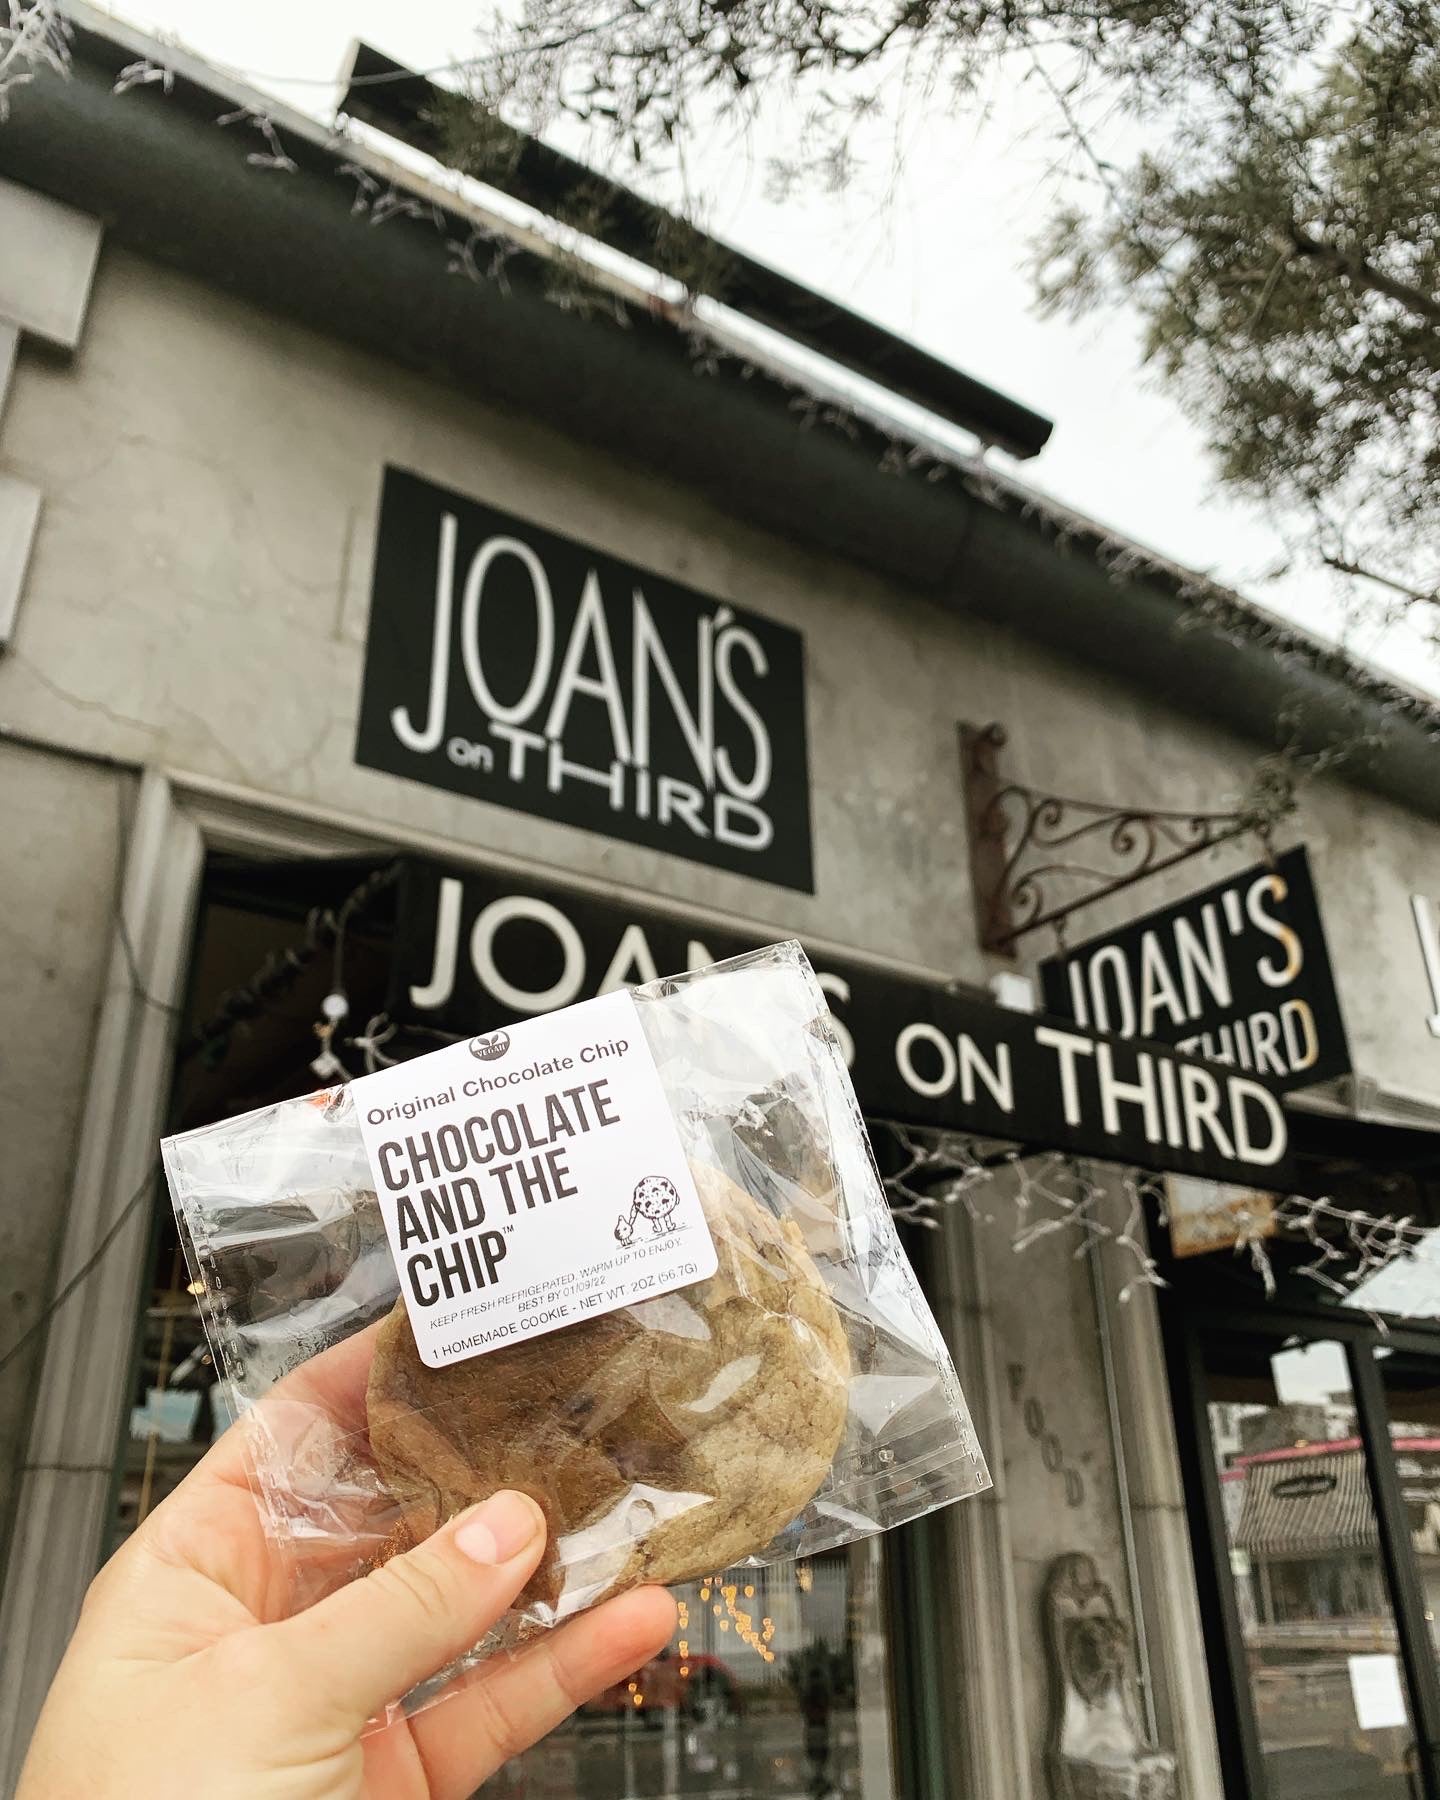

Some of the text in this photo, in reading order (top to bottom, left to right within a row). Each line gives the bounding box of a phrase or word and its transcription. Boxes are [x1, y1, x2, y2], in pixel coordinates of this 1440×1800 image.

[391, 512, 772, 802] JOAN'S
[446, 720, 774, 851] on THIRD
[367, 1039, 629, 1125] Original Chocolate Chip
[895, 1022, 1014, 1113] ON
[1034, 1025, 1288, 1166] THIRD
[378, 1079, 621, 1191] CHOCOLATE
[396, 1147, 578, 1250] AND THE
[430, 1312, 458, 1329] KEEP
[460, 1300, 496, 1319] FRESH
[579, 1260, 613, 1278] WARM
[615, 1254, 630, 1266] UP
[633, 1249, 646, 1260] TO
[442, 1322, 518, 1357] HOMEMADE
[520, 1305, 569, 1331] COOKIE
[580, 1292, 603, 1310] NET
[658, 1262, 698, 1285] (56.7G)
[518, 1275, 606, 1312] BEST BY 01/09/22
